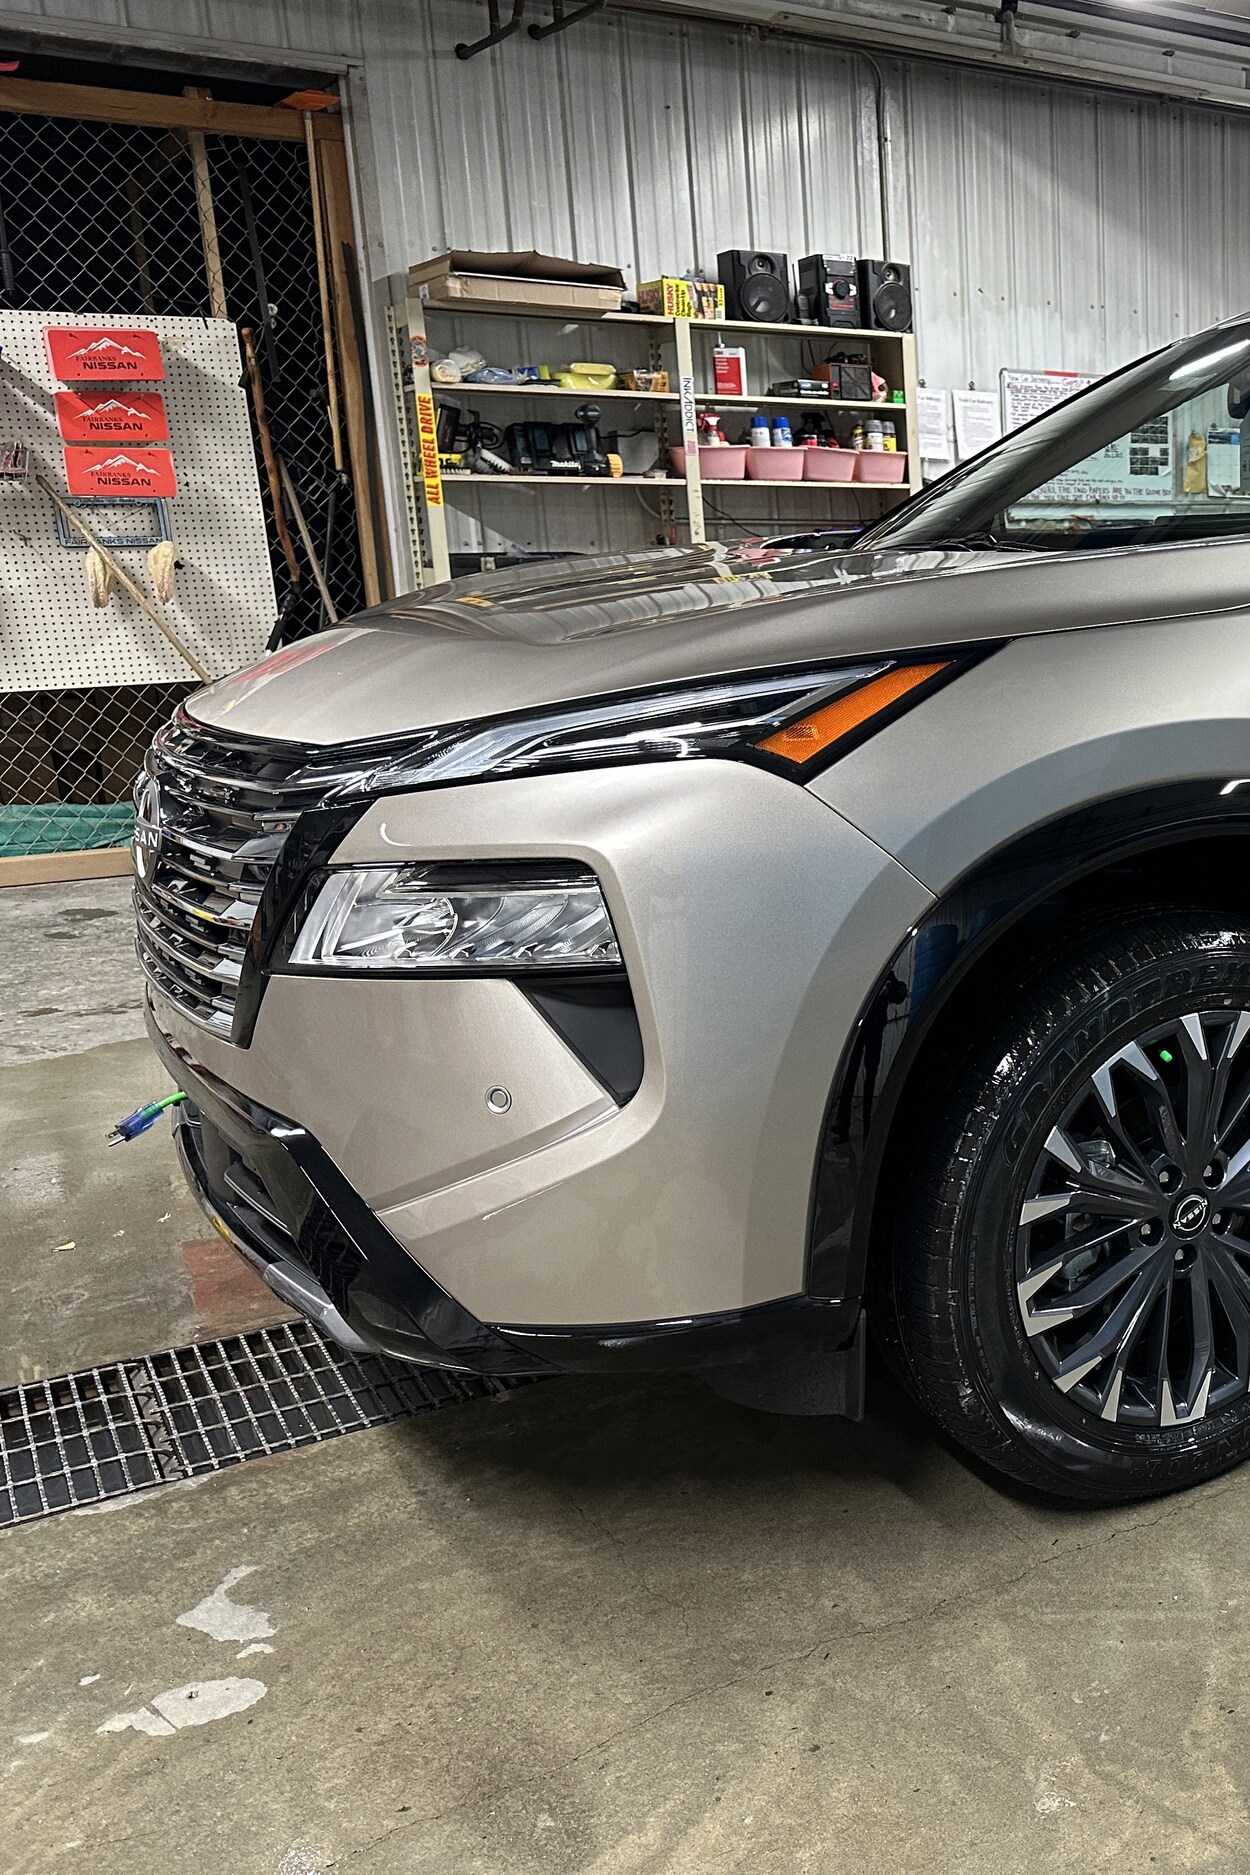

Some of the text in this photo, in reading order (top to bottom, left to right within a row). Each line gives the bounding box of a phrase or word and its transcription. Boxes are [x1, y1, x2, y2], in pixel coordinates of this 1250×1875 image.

[666, 284, 674, 315] HUSKY
[89, 422, 143, 430] NISSAN
[418, 395, 441, 505] ALL WHEEL DRIVE
[97, 477, 151, 486] NISSAN
[64, 538, 124, 546] FAIRANKS
[1173, 1198, 1208, 1230] NISSAN
